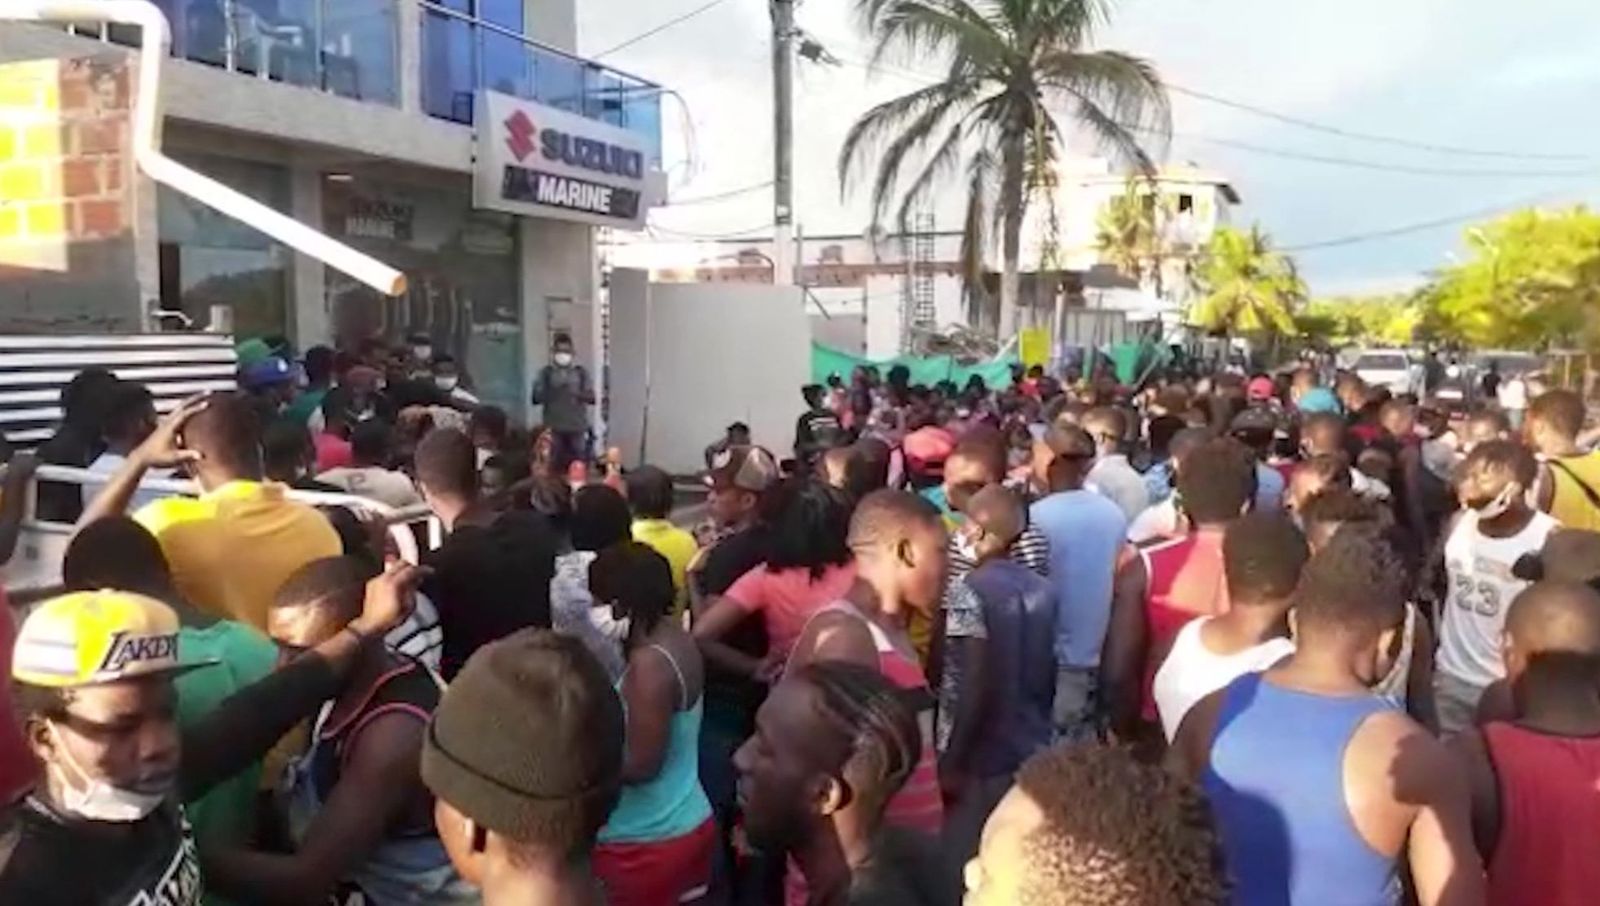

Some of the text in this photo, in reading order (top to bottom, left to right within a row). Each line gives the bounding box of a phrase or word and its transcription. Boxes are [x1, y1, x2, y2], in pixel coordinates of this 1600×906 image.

[541, 128, 643, 180] SUZUKI
[537, 174, 613, 214] MARINE
[1455, 572, 1500, 617] 23
